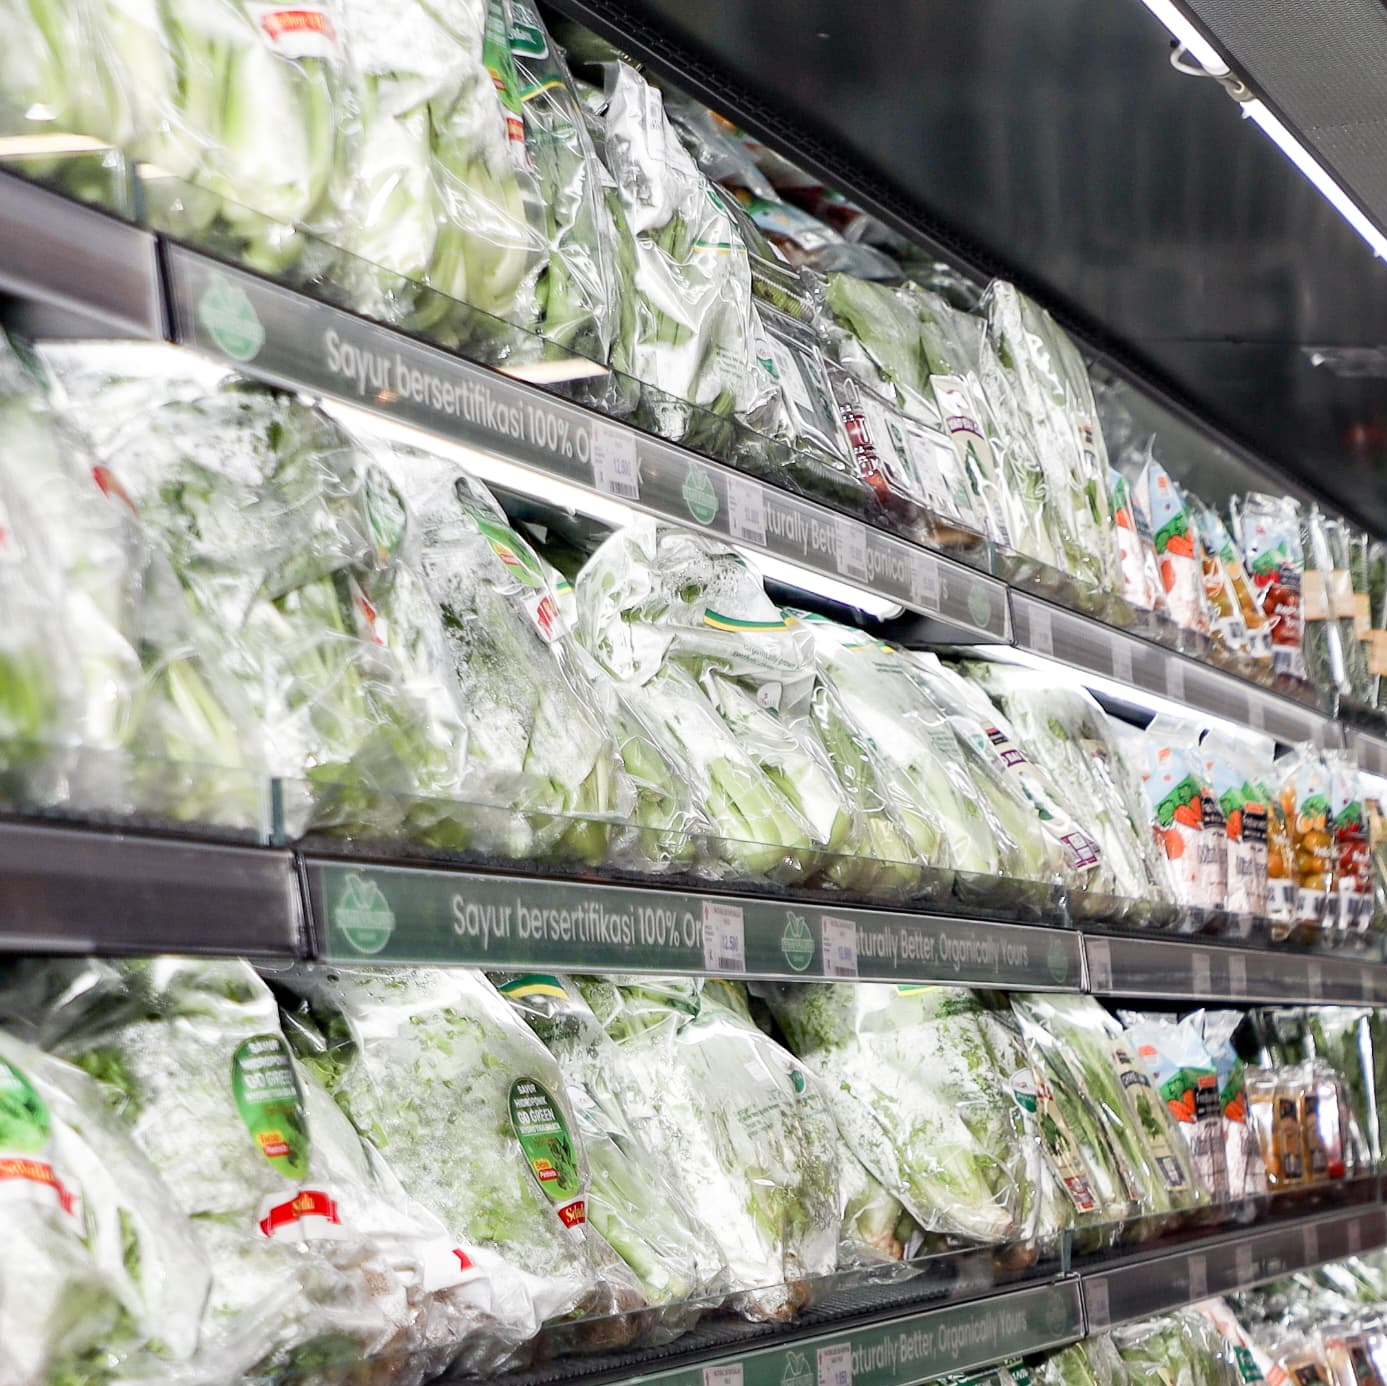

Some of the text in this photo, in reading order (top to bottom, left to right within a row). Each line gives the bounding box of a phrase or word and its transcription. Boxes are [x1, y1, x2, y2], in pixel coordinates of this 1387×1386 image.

[324, 327, 574, 458] Sayur bersertifikasi 100%
[767, 502, 810, 556] turally
[811, 522, 838, 551] Bett
[452, 894, 511, 951] Sayur
[517, 898, 637, 946] bersertifikasi
[638, 906, 681, 948] 100%
[856, 927, 899, 968] turally
[901, 932, 938, 963] Better,
[939, 934, 1001, 972] Organically
[516, 1108, 556, 1125] GO GREEN
[850, 1339, 899, 1383] aturally
[899, 1332, 937, 1361] Better,
